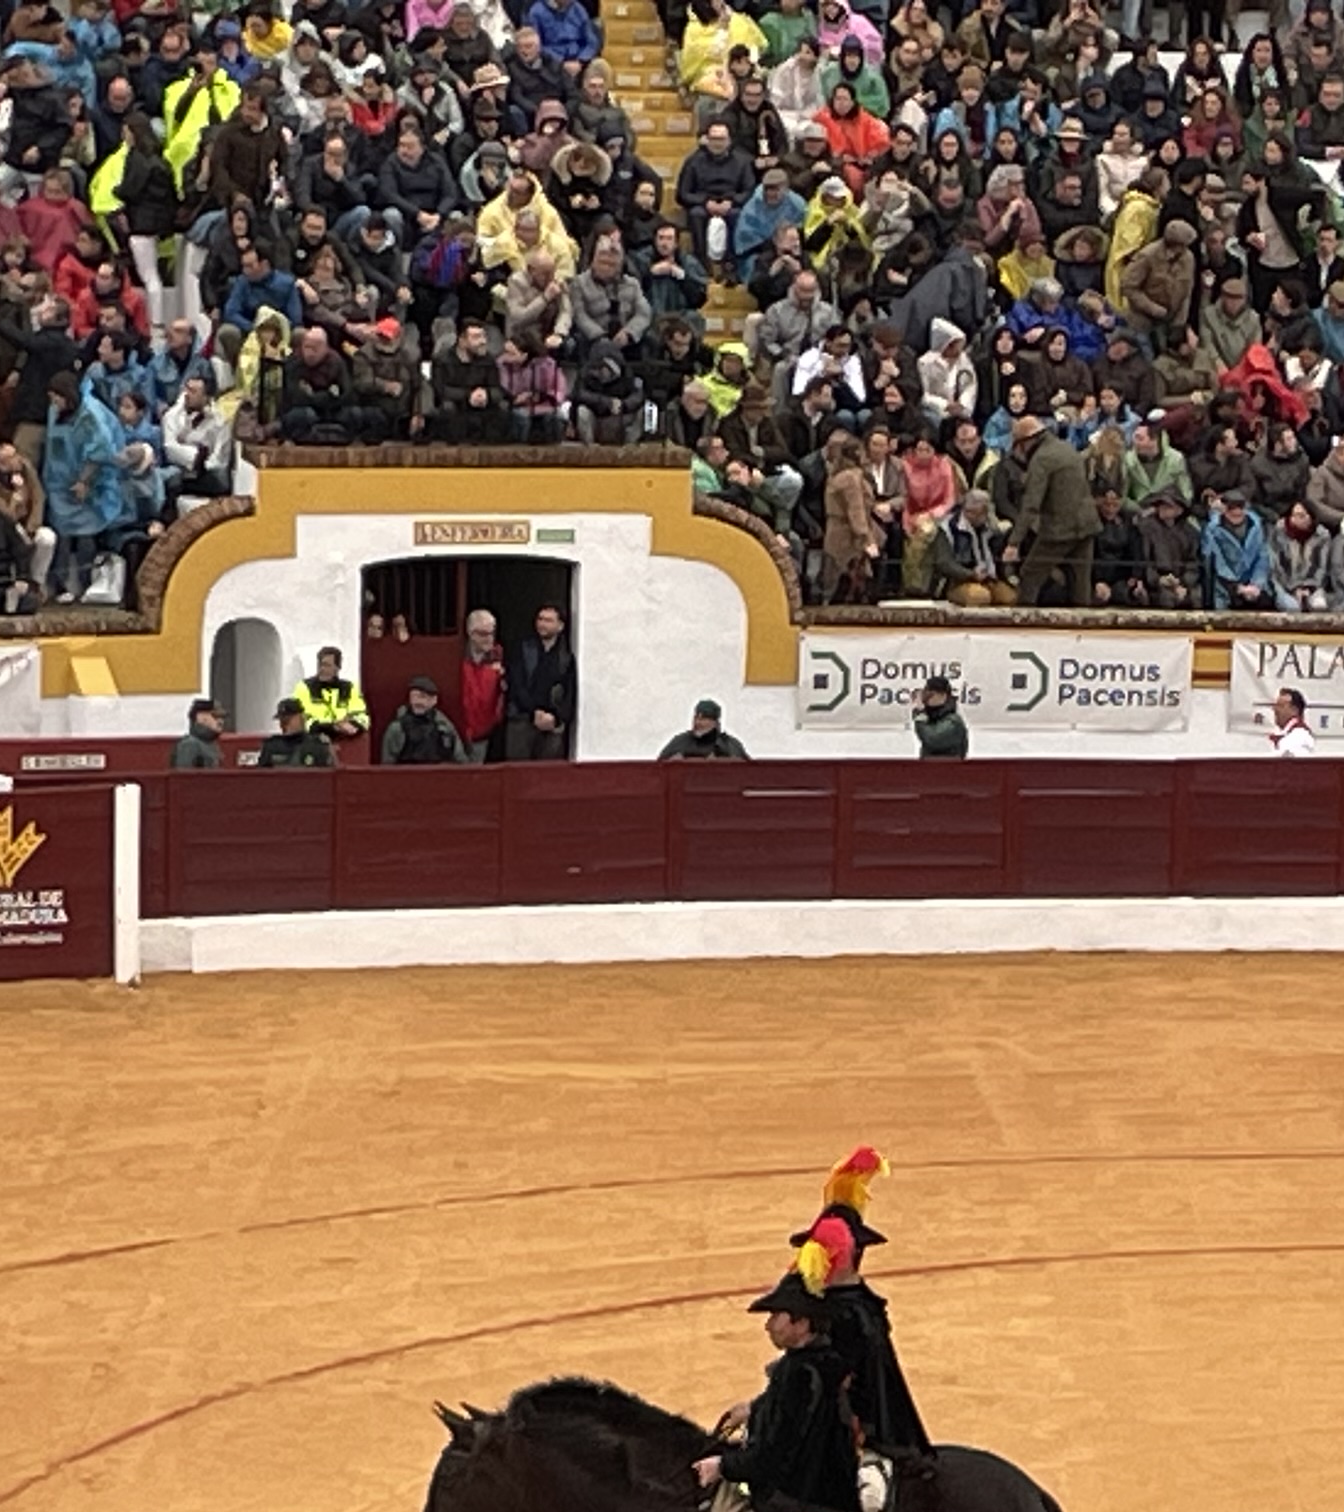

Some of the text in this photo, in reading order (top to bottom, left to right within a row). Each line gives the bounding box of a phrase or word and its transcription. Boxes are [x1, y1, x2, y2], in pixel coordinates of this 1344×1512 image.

[861, 658, 962, 681] Domus
[1059, 658, 1161, 682] Domus
[1059, 683, 1181, 708] Pacensis
